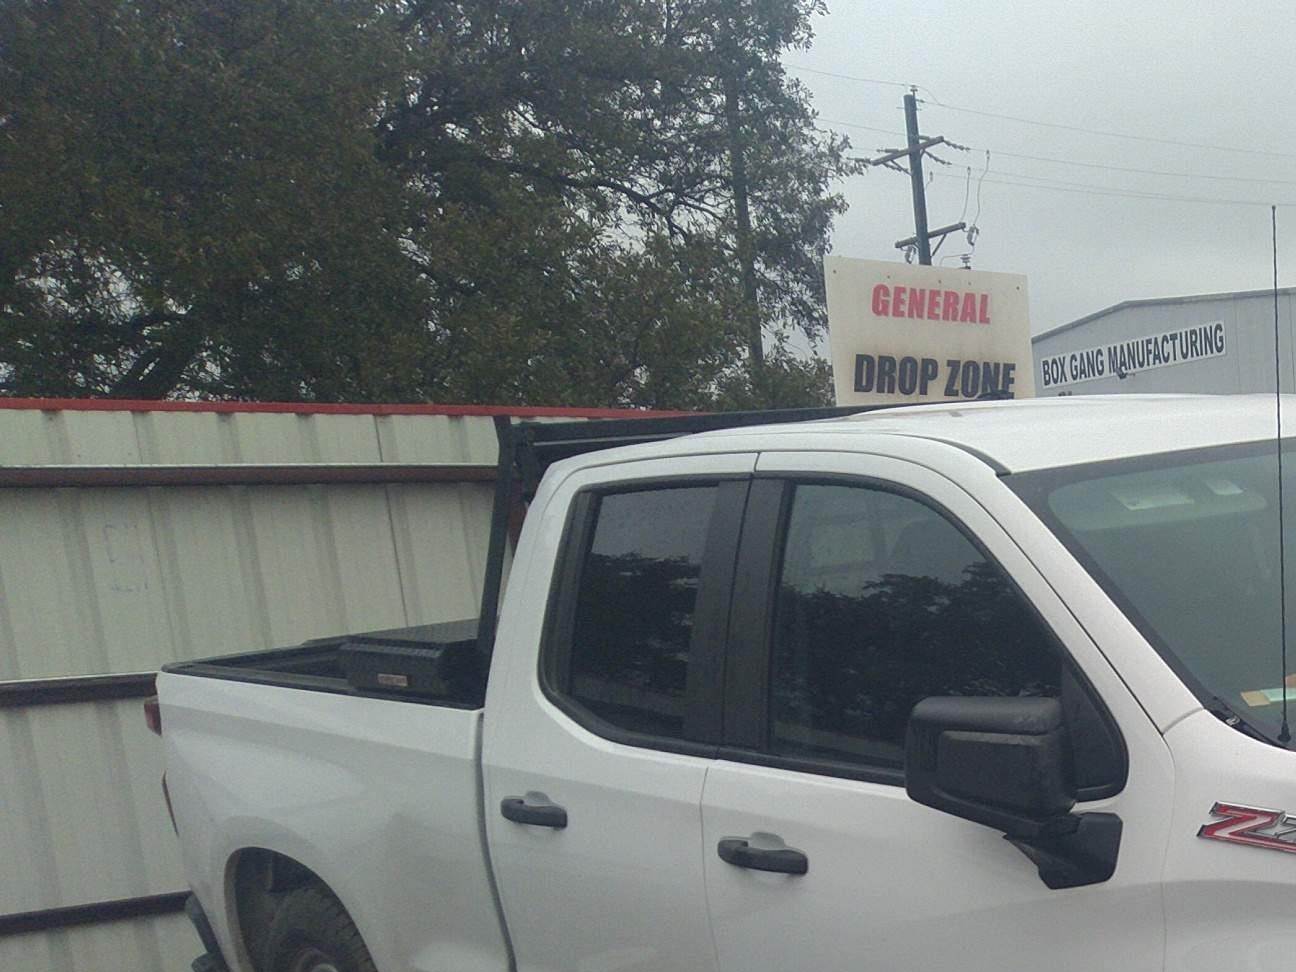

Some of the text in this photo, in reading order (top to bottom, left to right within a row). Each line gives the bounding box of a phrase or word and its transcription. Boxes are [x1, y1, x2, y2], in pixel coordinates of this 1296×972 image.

[871, 284, 991, 325] GENERAL
[854, 353, 1016, 399] DROP ZONE
[1042, 323, 1225, 386] BOX GANG MANUFACTURING
